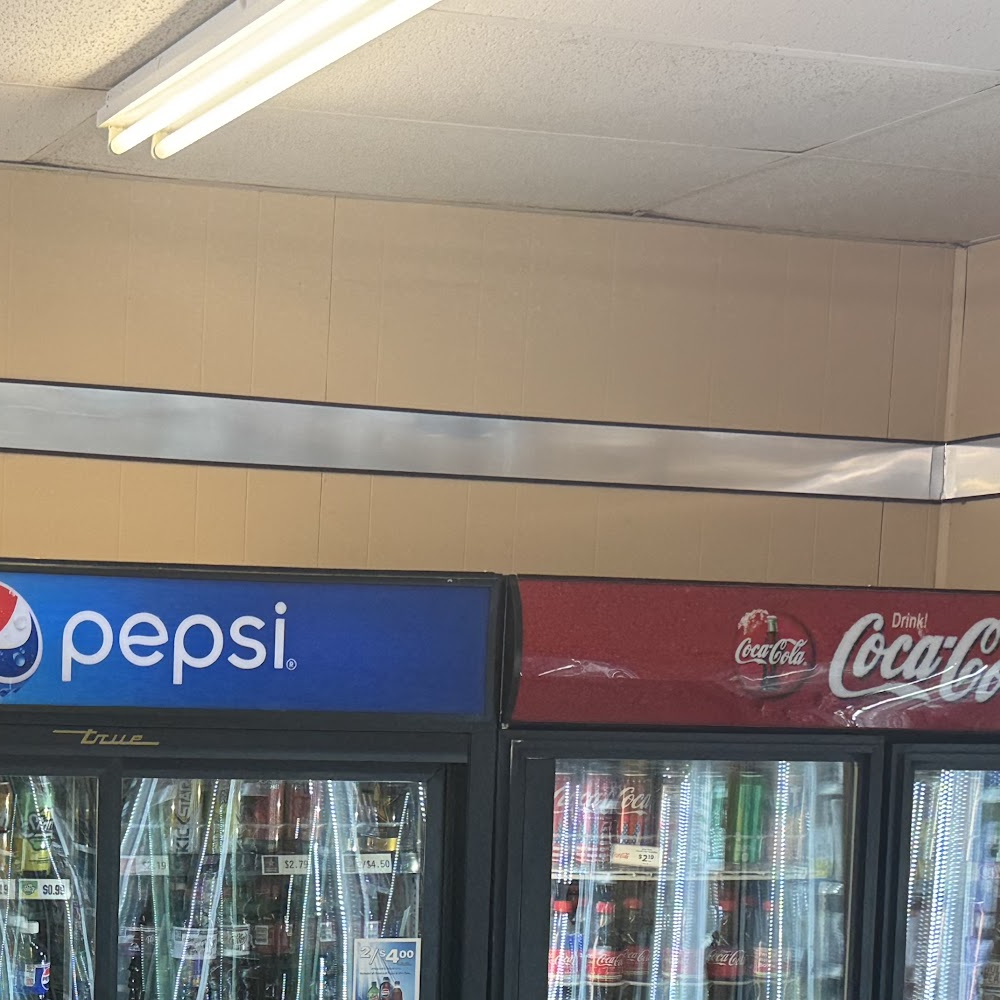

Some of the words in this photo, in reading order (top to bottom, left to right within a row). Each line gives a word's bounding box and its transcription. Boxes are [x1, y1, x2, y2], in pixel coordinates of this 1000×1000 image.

[892, 612, 928, 630] Drink!
[62, 602, 288, 685] pepsi
[735, 638, 808, 666] Coca-Cola
[828, 613, 1000, 703] Coca-Co
[60, 729, 155, 746] true
